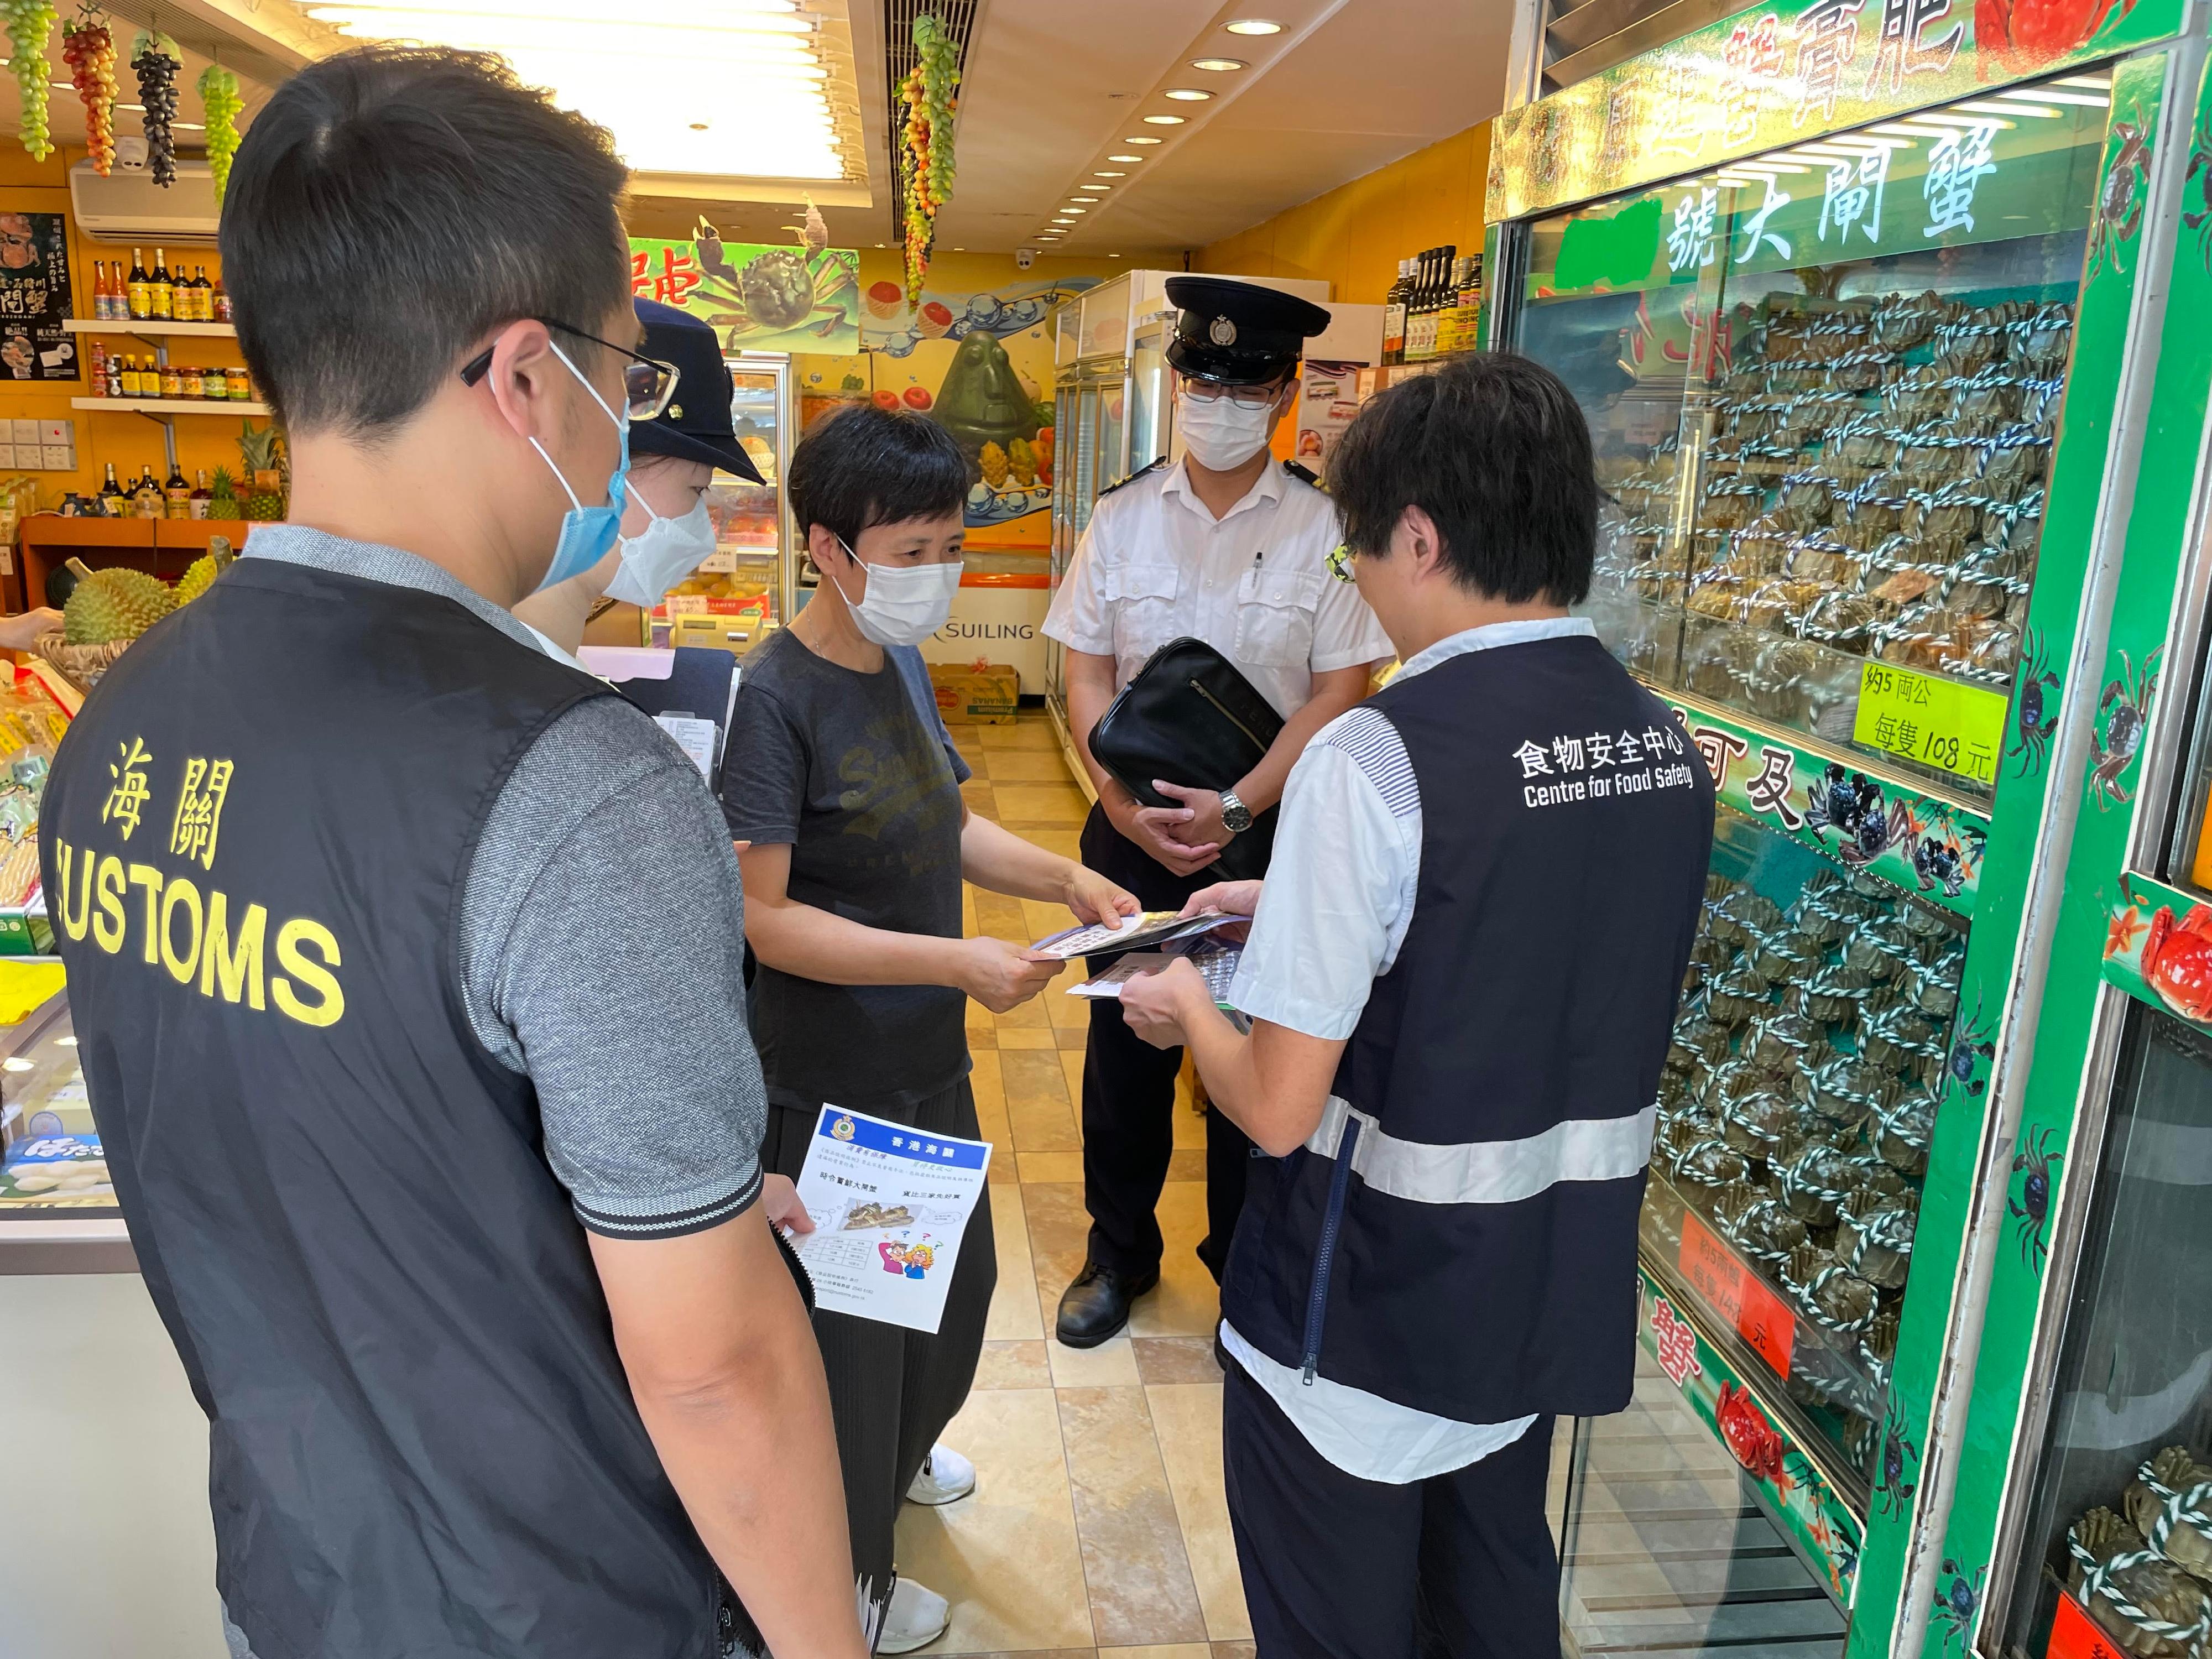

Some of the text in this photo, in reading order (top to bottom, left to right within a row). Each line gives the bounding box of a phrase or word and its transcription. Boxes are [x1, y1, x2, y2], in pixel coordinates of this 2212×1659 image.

[946, 623, 1033, 639] SUILING
[1512, 726, 1684, 779] 食物安全中心
[1671, 706, 1803, 831] 可及
[103, 737, 234, 871] 海關
[1524, 763, 1694, 808] Centre for Food Safety
